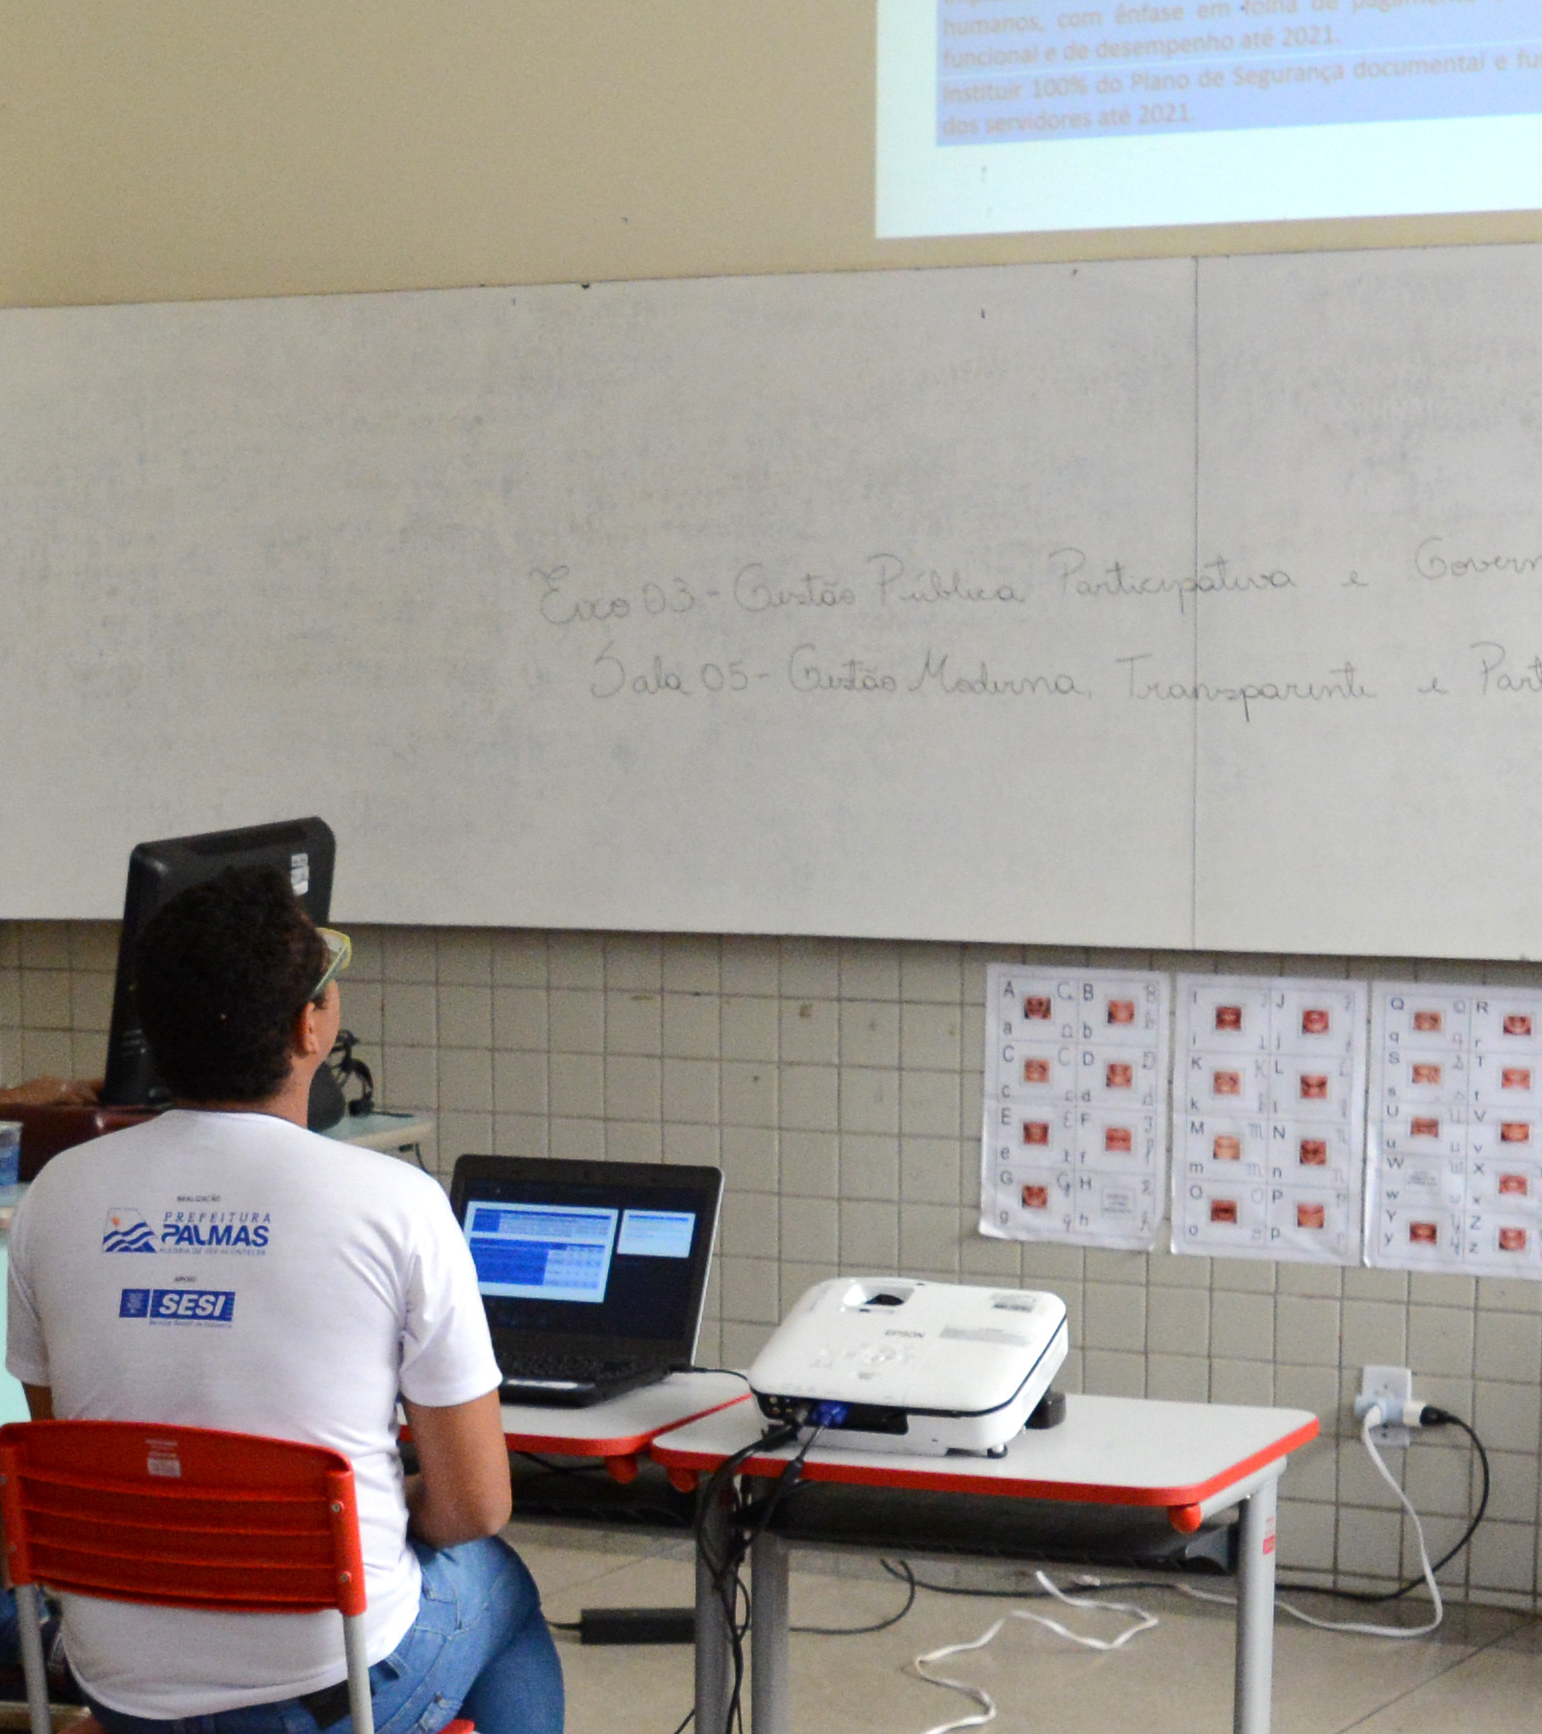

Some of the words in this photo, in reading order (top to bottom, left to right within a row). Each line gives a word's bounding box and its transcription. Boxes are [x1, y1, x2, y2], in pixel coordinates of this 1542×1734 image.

[943, 45, 1038, 68] funcional
[1044, 46, 1057, 61] e
[1064, 43, 1089, 61] de
[1096, 36, 1236, 60] desempenho
[1240, 29, 1275, 49] até
[1034, 77, 1088, 99] 100%
[1097, 77, 1124, 95] do
[1131, 71, 1191, 92] Plano
[1198, 71, 1225, 89] de
[1233, 62, 1345, 89] Segurança
[1354, 54, 1485, 80] documental
[1495, 55, 1507, 71] e
[943, 116, 980, 136] dos
[986, 112, 1092, 134] servidores
[1098, 107, 1131, 126] até
[732, 562, 856, 613] Gestão
[867, 552, 1027, 608] Pública
[1048, 546, 1298, 614] Participativa
[1340, 568, 1369, 589] e
[591, 640, 692, 700] Sala
[787, 642, 898, 694] Gestão
[1115, 653, 1379, 723] Transparente
[1416, 676, 1447, 696] e
[1004, 981, 1015, 998] A
[1083, 984, 1094, 1000] B
[1390, 997, 1405, 1011] Q
[1476, 1000, 1490, 1014] R
[1002, 1046, 1015, 1063] C
[1083, 1051, 1095, 1066] D
[1191, 1056, 1203, 1071] K
[1001, 1108, 1012, 1125] E
[1190, 1121, 1205, 1136] M
[1273, 1126, 1286, 1140] N
[1000, 1170, 1014, 1186] G
[1080, 1175, 1092, 1190] H
[163, 1211, 271, 1224] PREFEITURA
[161, 1224, 270, 1248] PALMAS
[159, 1293, 227, 1317] SESI
